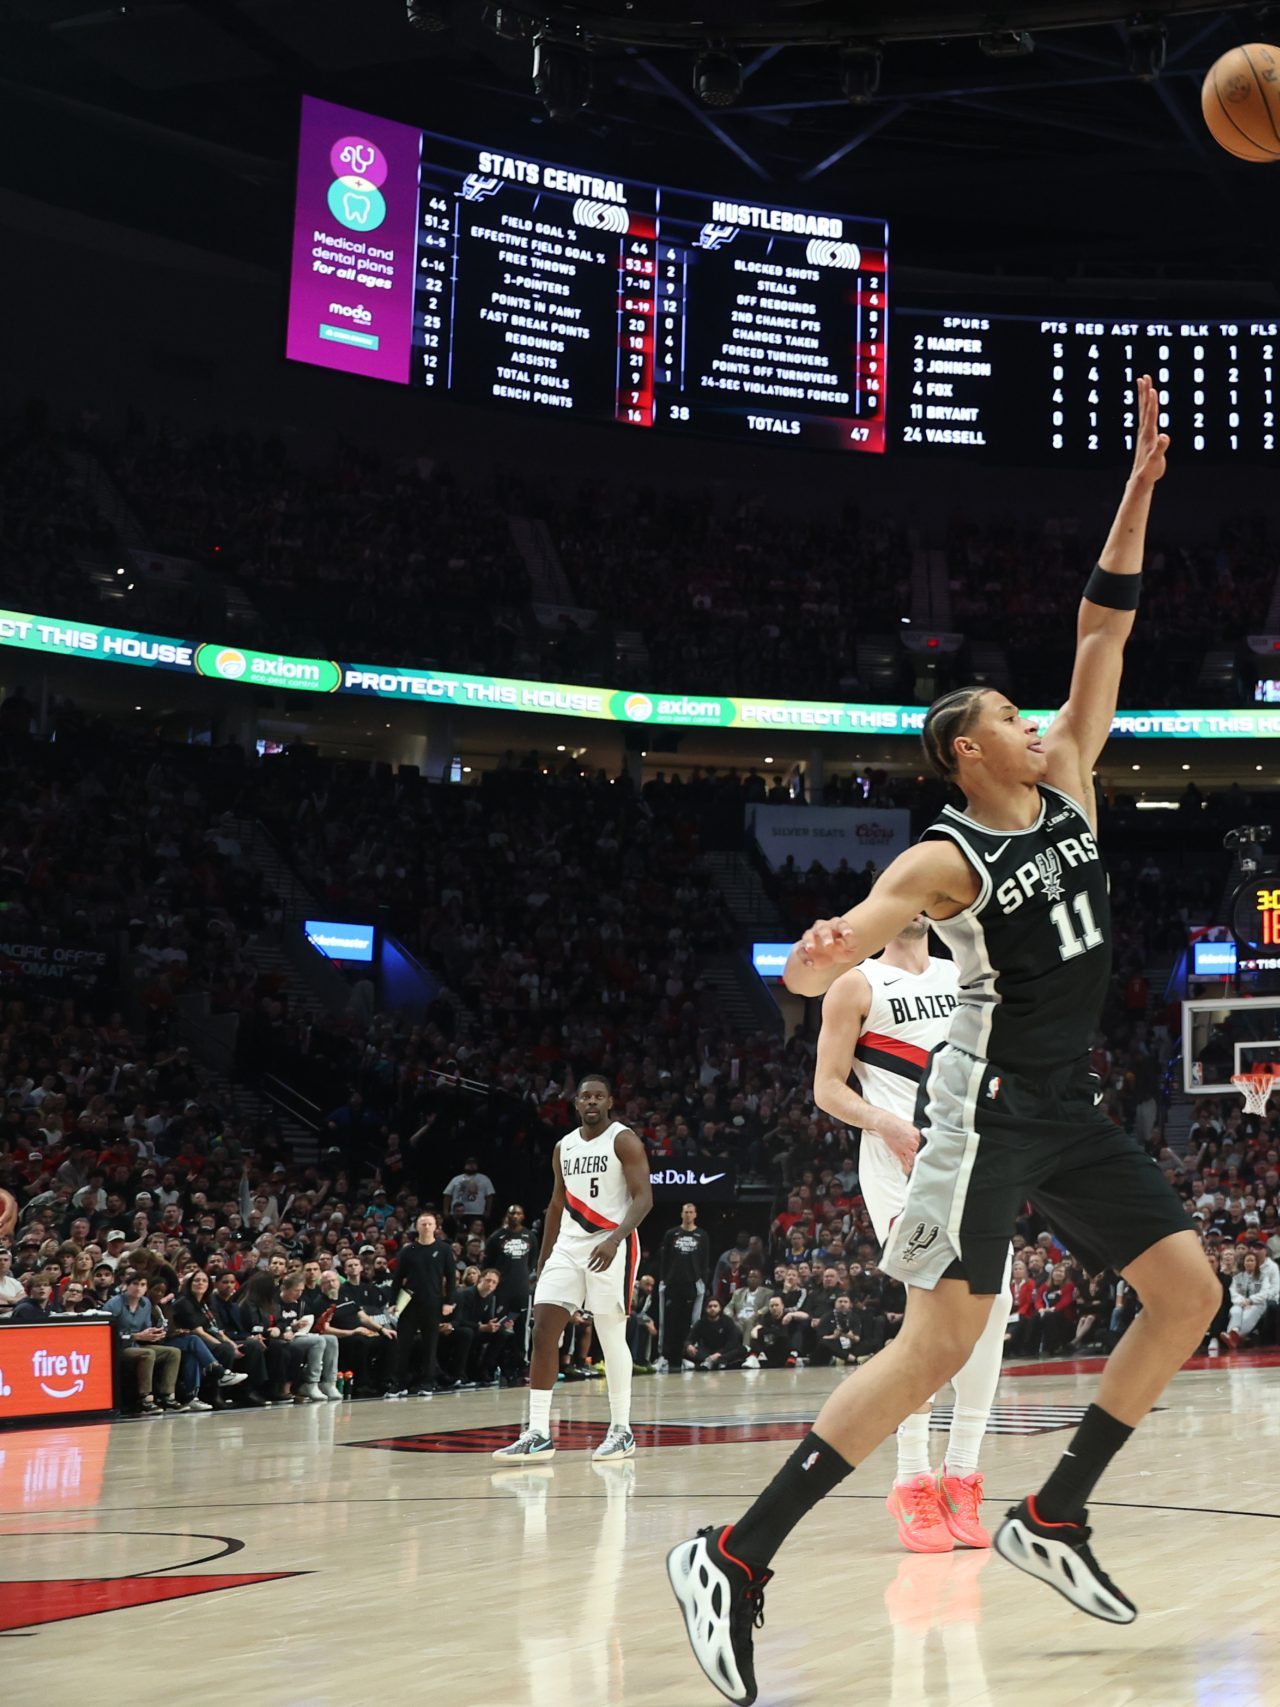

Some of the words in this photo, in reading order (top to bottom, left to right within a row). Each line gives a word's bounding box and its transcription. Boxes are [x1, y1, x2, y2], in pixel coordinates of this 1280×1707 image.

[479, 152, 540, 185] STATS
[543, 167, 628, 204] CENTRAL
[424, 214, 450, 231] 51.2
[501, 215, 533, 231] FIELD
[535, 223, 565, 239] GOAL
[712, 201, 843, 238] HUSTLEBOARD
[313, 230, 366, 254] Medical
[367, 247, 394, 261] and
[470, 226, 529, 249] EFFECTIVE
[531, 240, 563, 256] FIELD
[564, 247, 594, 263] GOAL
[312, 246, 356, 266] dental
[357, 258, 394, 275] plans
[499, 250, 528, 266] FREE
[530, 257, 577, 276] THROWS
[626, 258, 653, 273] 53.5
[734, 259, 783, 277] BLOCKED
[785, 267, 820, 281] SHOTS
[312, 260, 335, 275] for
[336, 269, 356, 280] all
[357, 273, 392, 289] ages
[503, 273, 570, 297] 3-POINTERS
[757, 280, 796, 295] STEALS
[329, 302, 372, 321] moda
[491, 292, 531, 310] POINTS
[534, 301, 547, 313] IN
[548, 304, 582, 320] PAINT
[736, 294, 757, 306] OFF
[760, 297, 816, 315] REBOUNDS
[480, 308, 509, 323] FAST
[511, 314, 549, 332] BREAK
[551, 322, 590, 339] POINTS
[731, 310, 754, 324] 2ND
[755, 314, 798, 330] CHANCE
[800, 319, 821, 332] PTS
[943, 317, 990, 330] SPURS
[1041, 322, 1068, 335] PTS
[1075, 323, 1105, 336] REB
[1111, 324, 1139, 336] AST
[1146, 324, 1173, 337] STL
[1180, 324, 1209, 337] BLK
[1219, 324, 1239, 337] TO
[1250, 324, 1278, 336] FLS
[505, 331, 565, 352] REBOUNDS
[732, 328, 783, 345] CHARGES
[784, 335, 819, 349] TAKEN
[927, 337, 982, 353] HARPER
[510, 351, 557, 369] ASSISTS
[722, 343, 765, 359] FORCED
[766, 349, 829, 367] TURNOVERS
[497, 366, 531, 383] TOTAL
[534, 373, 570, 390] FOULS
[712, 359, 751, 375] POINTS
[753, 365, 774, 378] OFF
[776, 368, 838, 385] TURNOVERS
[926, 360, 991, 376] JOHNSON
[492, 384, 531, 401] BENCH
[534, 392, 573, 408] POINTS
[701, 376, 741, 391] 24-SEC
[743, 381, 805, 399] VIOLATIONS
[807, 389, 850, 404] FORCED
[926, 382, 953, 397] FOX
[670, 405, 690, 421] 38
[910, 403, 923, 419] 11
[926, 406, 979, 421] BRYANT
[747, 415, 801, 435] TOTALS
[850, 427, 870, 442] 47
[903, 426, 923, 442] 24
[925, 429, 986, 445] VASSELL
[37, 623, 98, 652] THIS
[102, 634, 193, 667] HOUSE
[251, 655, 320, 681] axiom
[344, 670, 459, 700] PROTECT
[462, 681, 517, 705] THIS
[521, 688, 602, 713] HOUSE
[656, 697, 722, 717] axiom
[740, 705, 848, 728] PROTECT
[850, 709, 899, 730] THIS
[1205, 717, 1249, 733] THIS
[771, 827, 809, 838] SILVER
[813, 828, 845, 838] SEATS
[997, 832, 1099, 916] SPURS
[1049, 891, 1104, 961] 11
[888, 994, 958, 1025] BLAZER
[563, 1155, 608, 1177] BLAZERS
[590, 1178, 599, 1198] 5
[665, 1170, 685, 1185] Do
[32, 1350, 68, 1378] fire
[69, 1350, 91, 1376] tv
